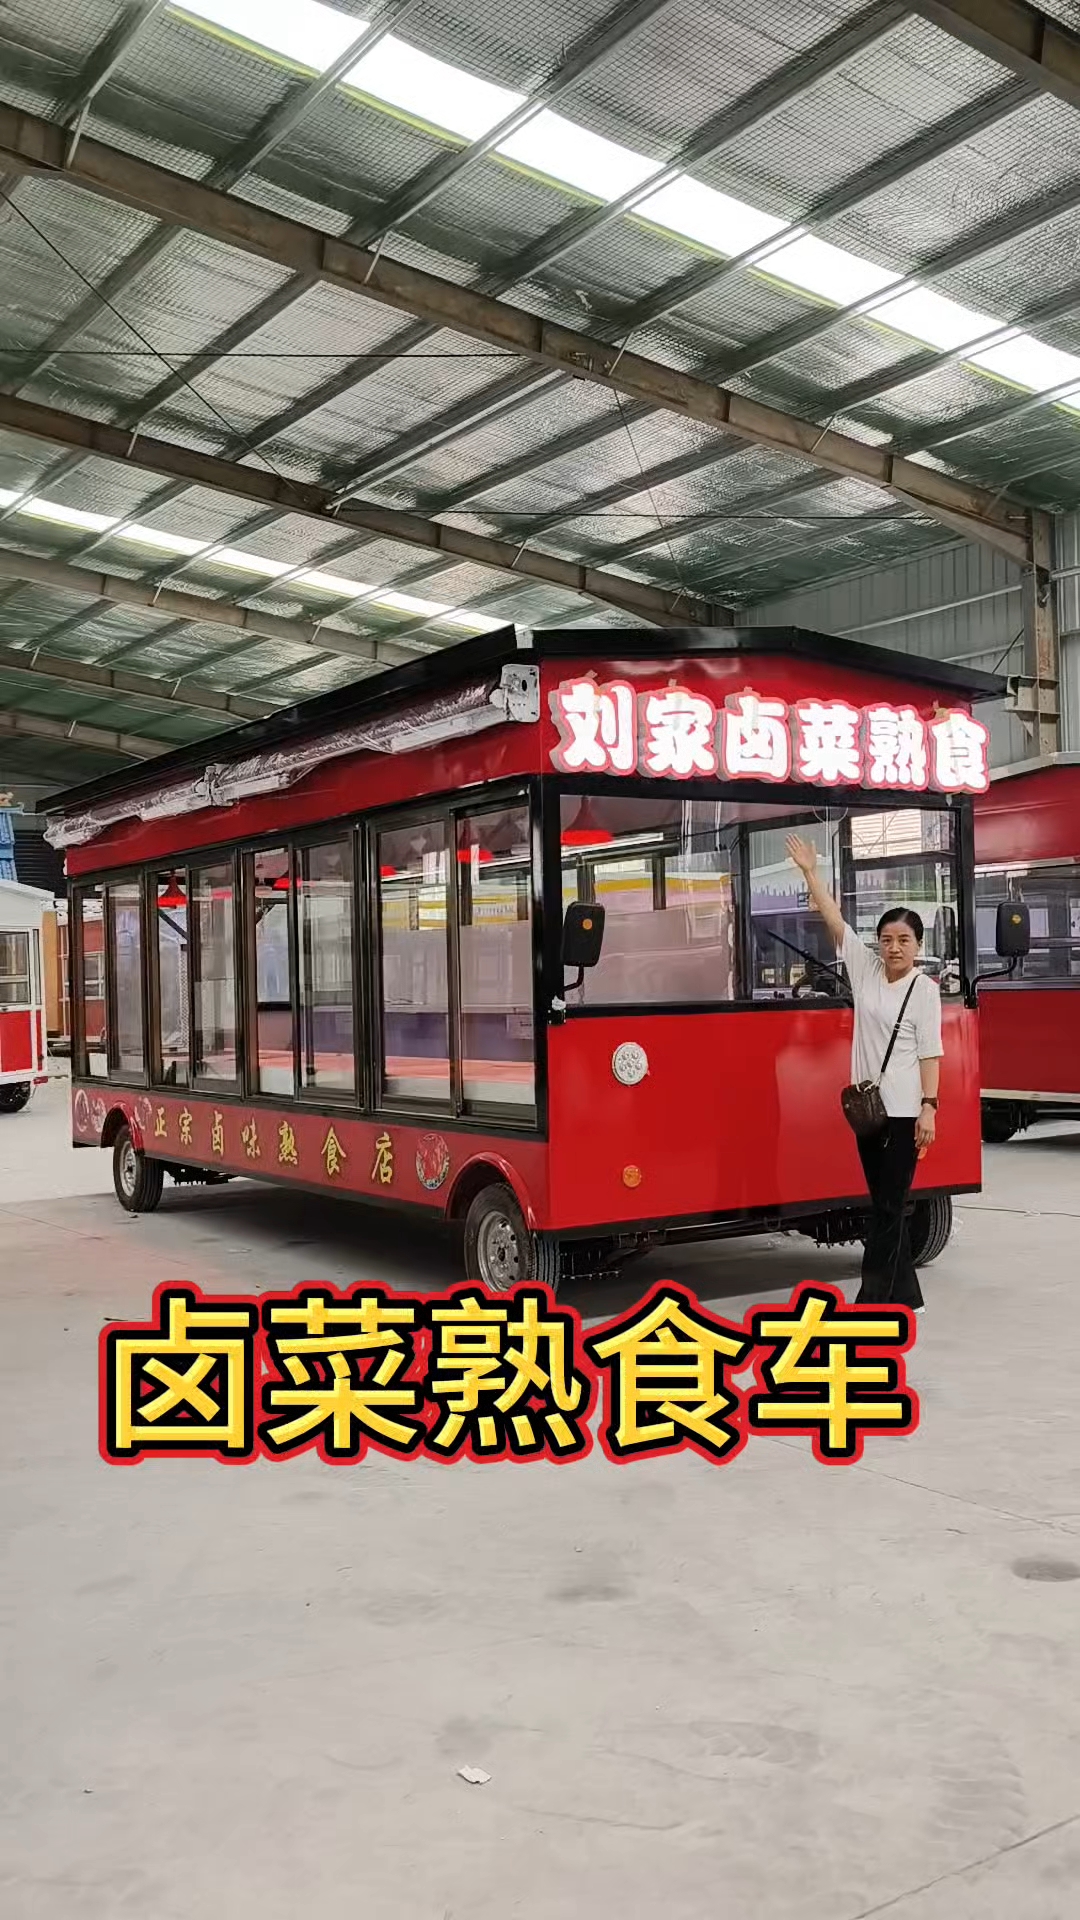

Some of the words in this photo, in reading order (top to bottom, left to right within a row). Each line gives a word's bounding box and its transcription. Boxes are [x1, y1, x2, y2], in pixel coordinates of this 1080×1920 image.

[553, 680, 989, 792] 刘家卤菜熟食
[154, 1106, 394, 1184] 正宗卤味熟食店
